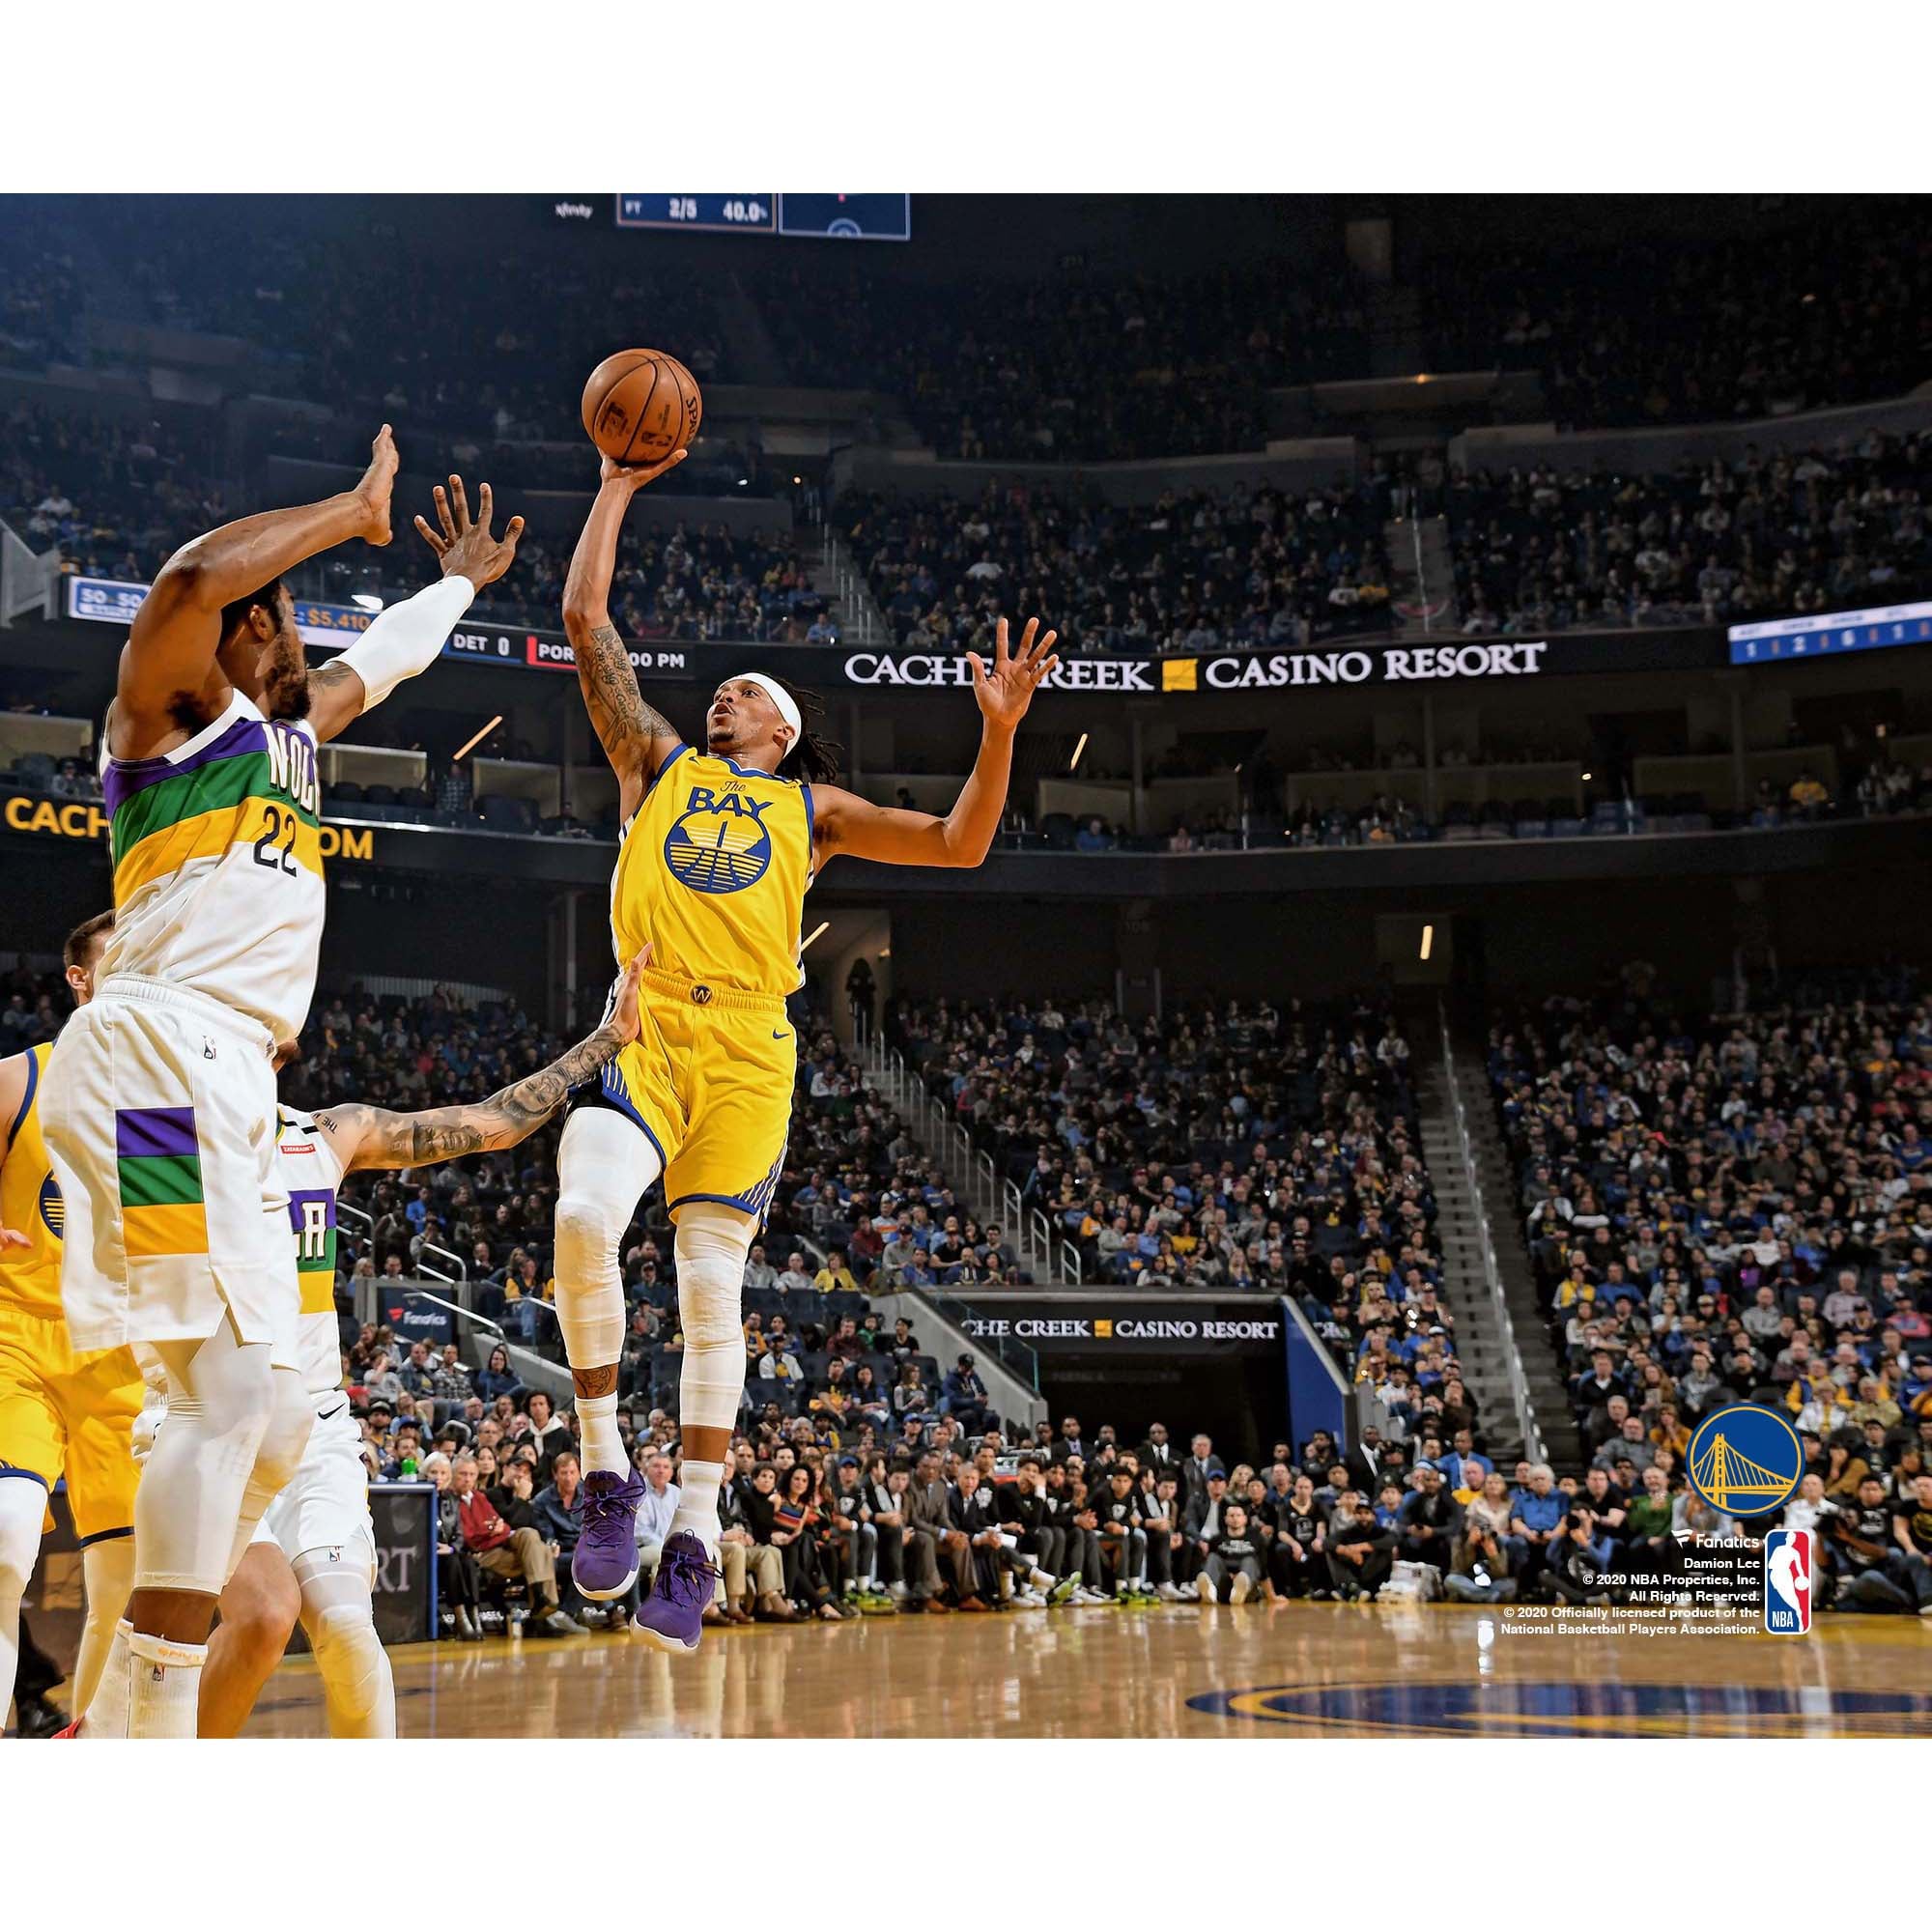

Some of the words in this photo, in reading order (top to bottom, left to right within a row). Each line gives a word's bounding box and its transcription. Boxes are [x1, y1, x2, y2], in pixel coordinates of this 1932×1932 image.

[452, 633, 488, 651] DET
[538, 643, 577, 662] POR
[657, 653, 686, 669] PM
[1205, 652, 1374, 689] CASINO
[1383, 641, 1548, 681] RESORT
[687, 786, 775, 818] BAY
[720, 781, 747, 793] The
[253, 805, 298, 877] 22
[717, 820, 728, 848] 1
[403, 1311, 447, 1326] Fanatics
[1014, 1320, 1092, 1338] CREEK
[1115, 1321, 1198, 1338] CASINO
[1202, 1321, 1278, 1339] RESORT
